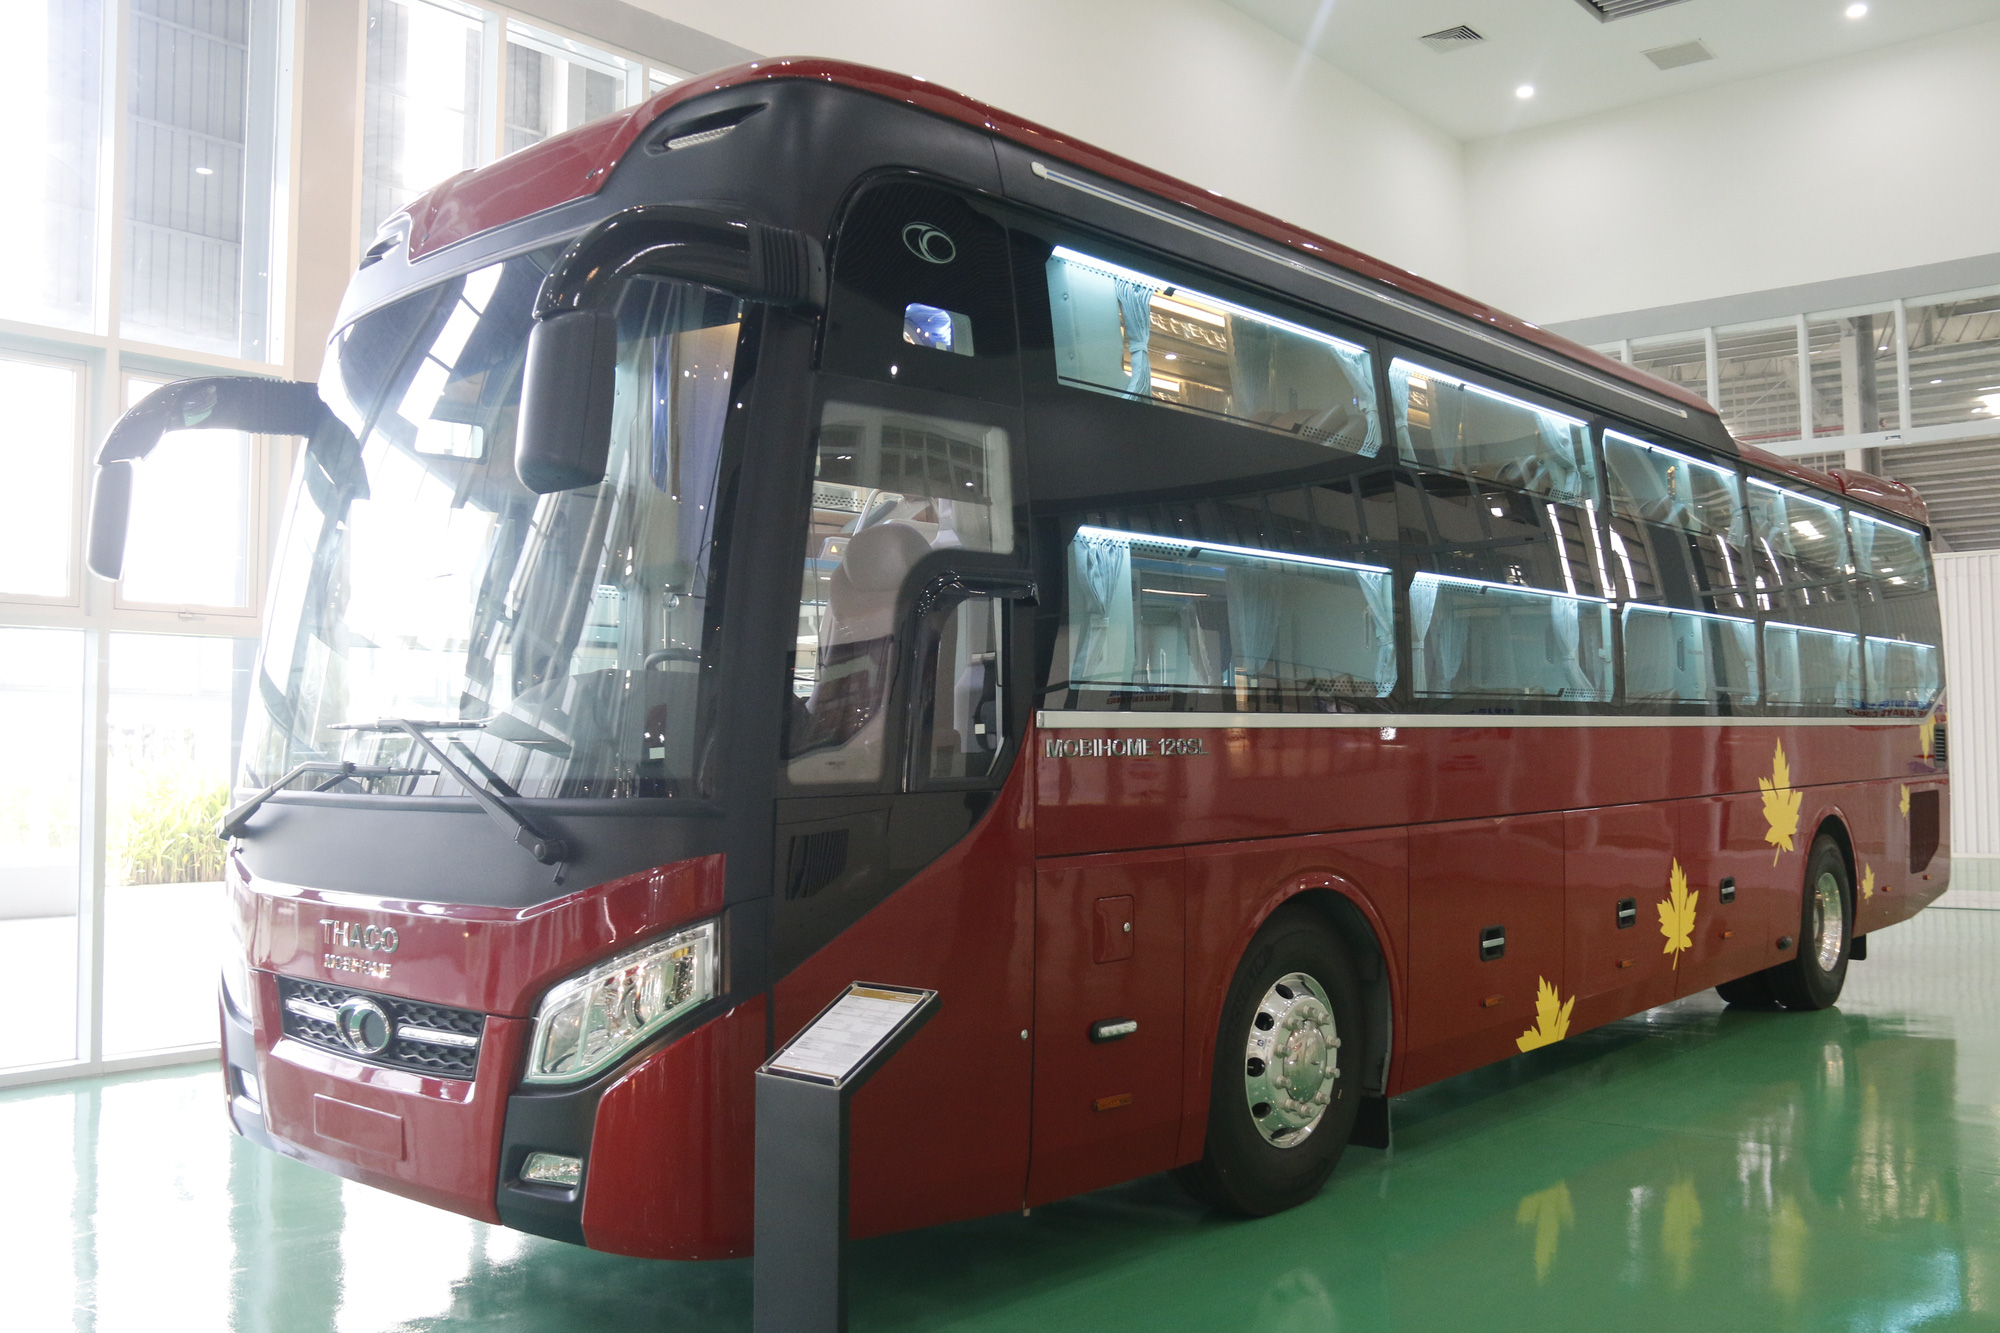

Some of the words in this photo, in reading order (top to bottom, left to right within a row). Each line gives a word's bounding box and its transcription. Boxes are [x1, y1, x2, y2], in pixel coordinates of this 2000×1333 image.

[1046, 738, 1153, 757] MOBIHOME
[1157, 738, 1209, 756] 120SL
[319, 919, 399, 954] THACO
